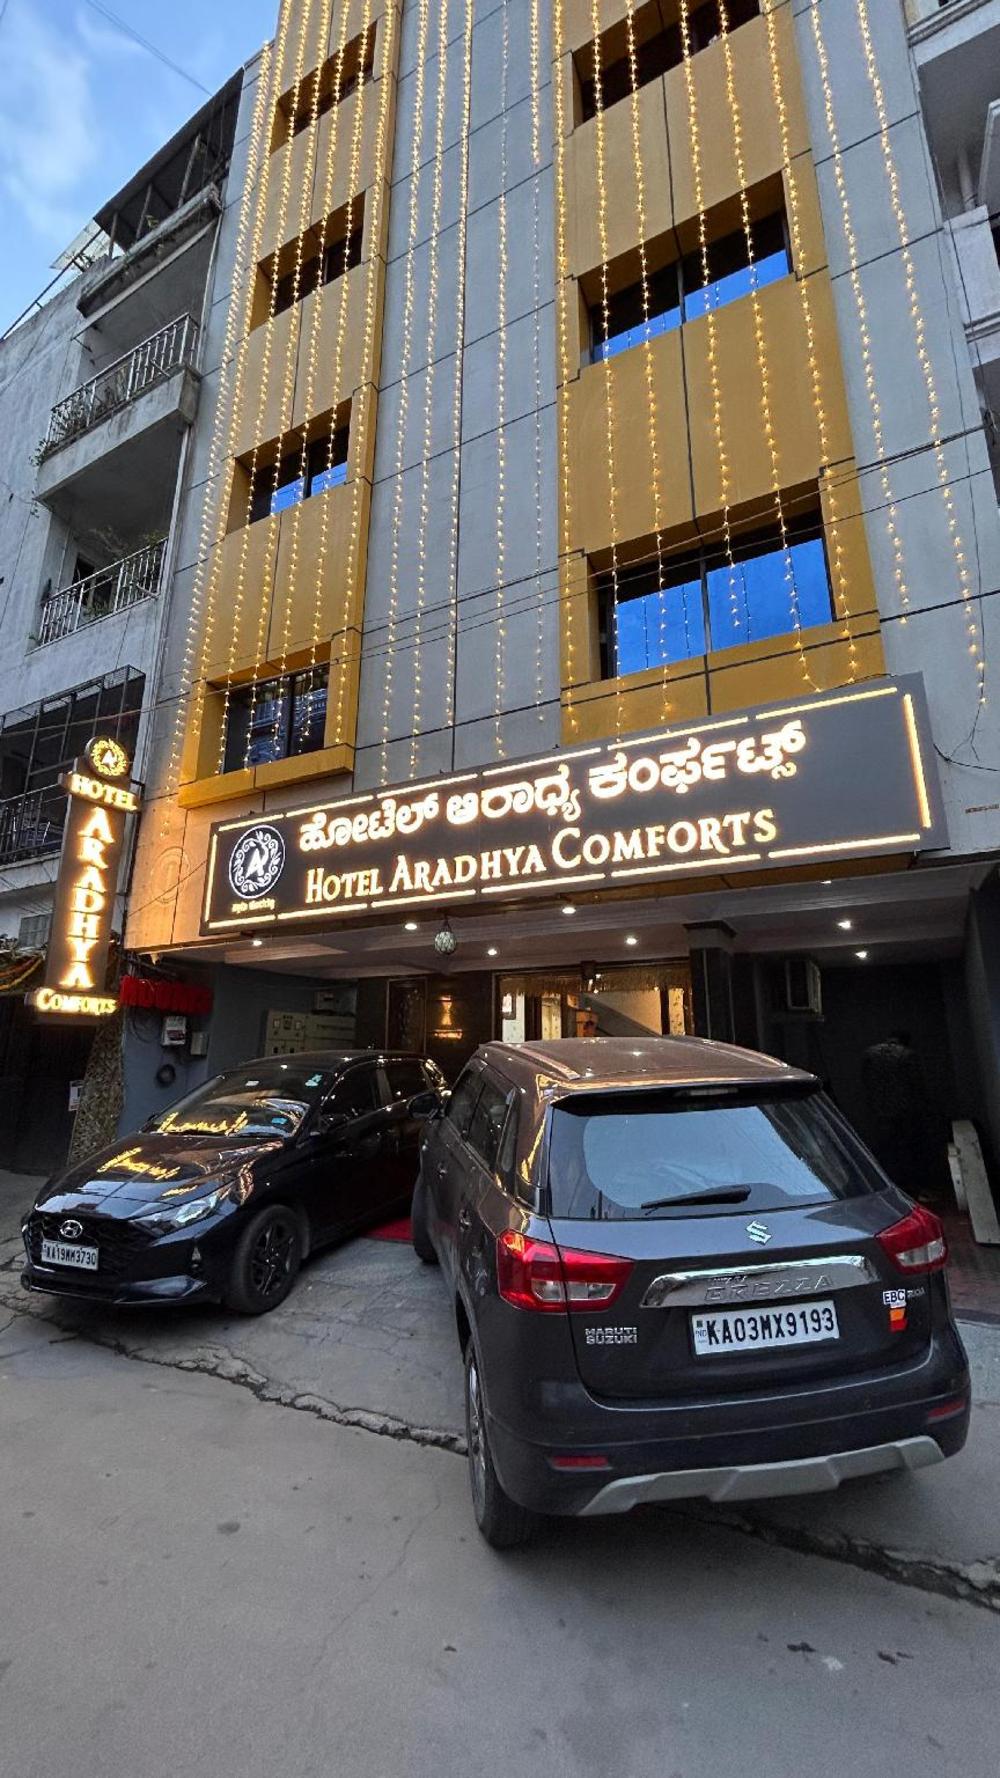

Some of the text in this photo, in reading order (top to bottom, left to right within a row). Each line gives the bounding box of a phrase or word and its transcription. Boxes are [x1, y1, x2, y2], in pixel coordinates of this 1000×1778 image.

[71, 773, 138, 811] HOTEL
[300, 793, 439, 852] ಹೋಟೆಲ್
[446, 764, 581, 825] ಆರಾಧ್ಯ
[307, 809, 777, 905] HOTEL ARADHYA COMFORTS
[58, 806, 115, 989] ARADHYA
[36, 987, 118, 1015] COMFORTS
[884, 1291, 906, 1303] EBC
[585, 1327, 638, 1335] MARUTI
[586, 1334, 638, 1344] SUZUKI
[707, 1308, 835, 1346] KA03MX9193
